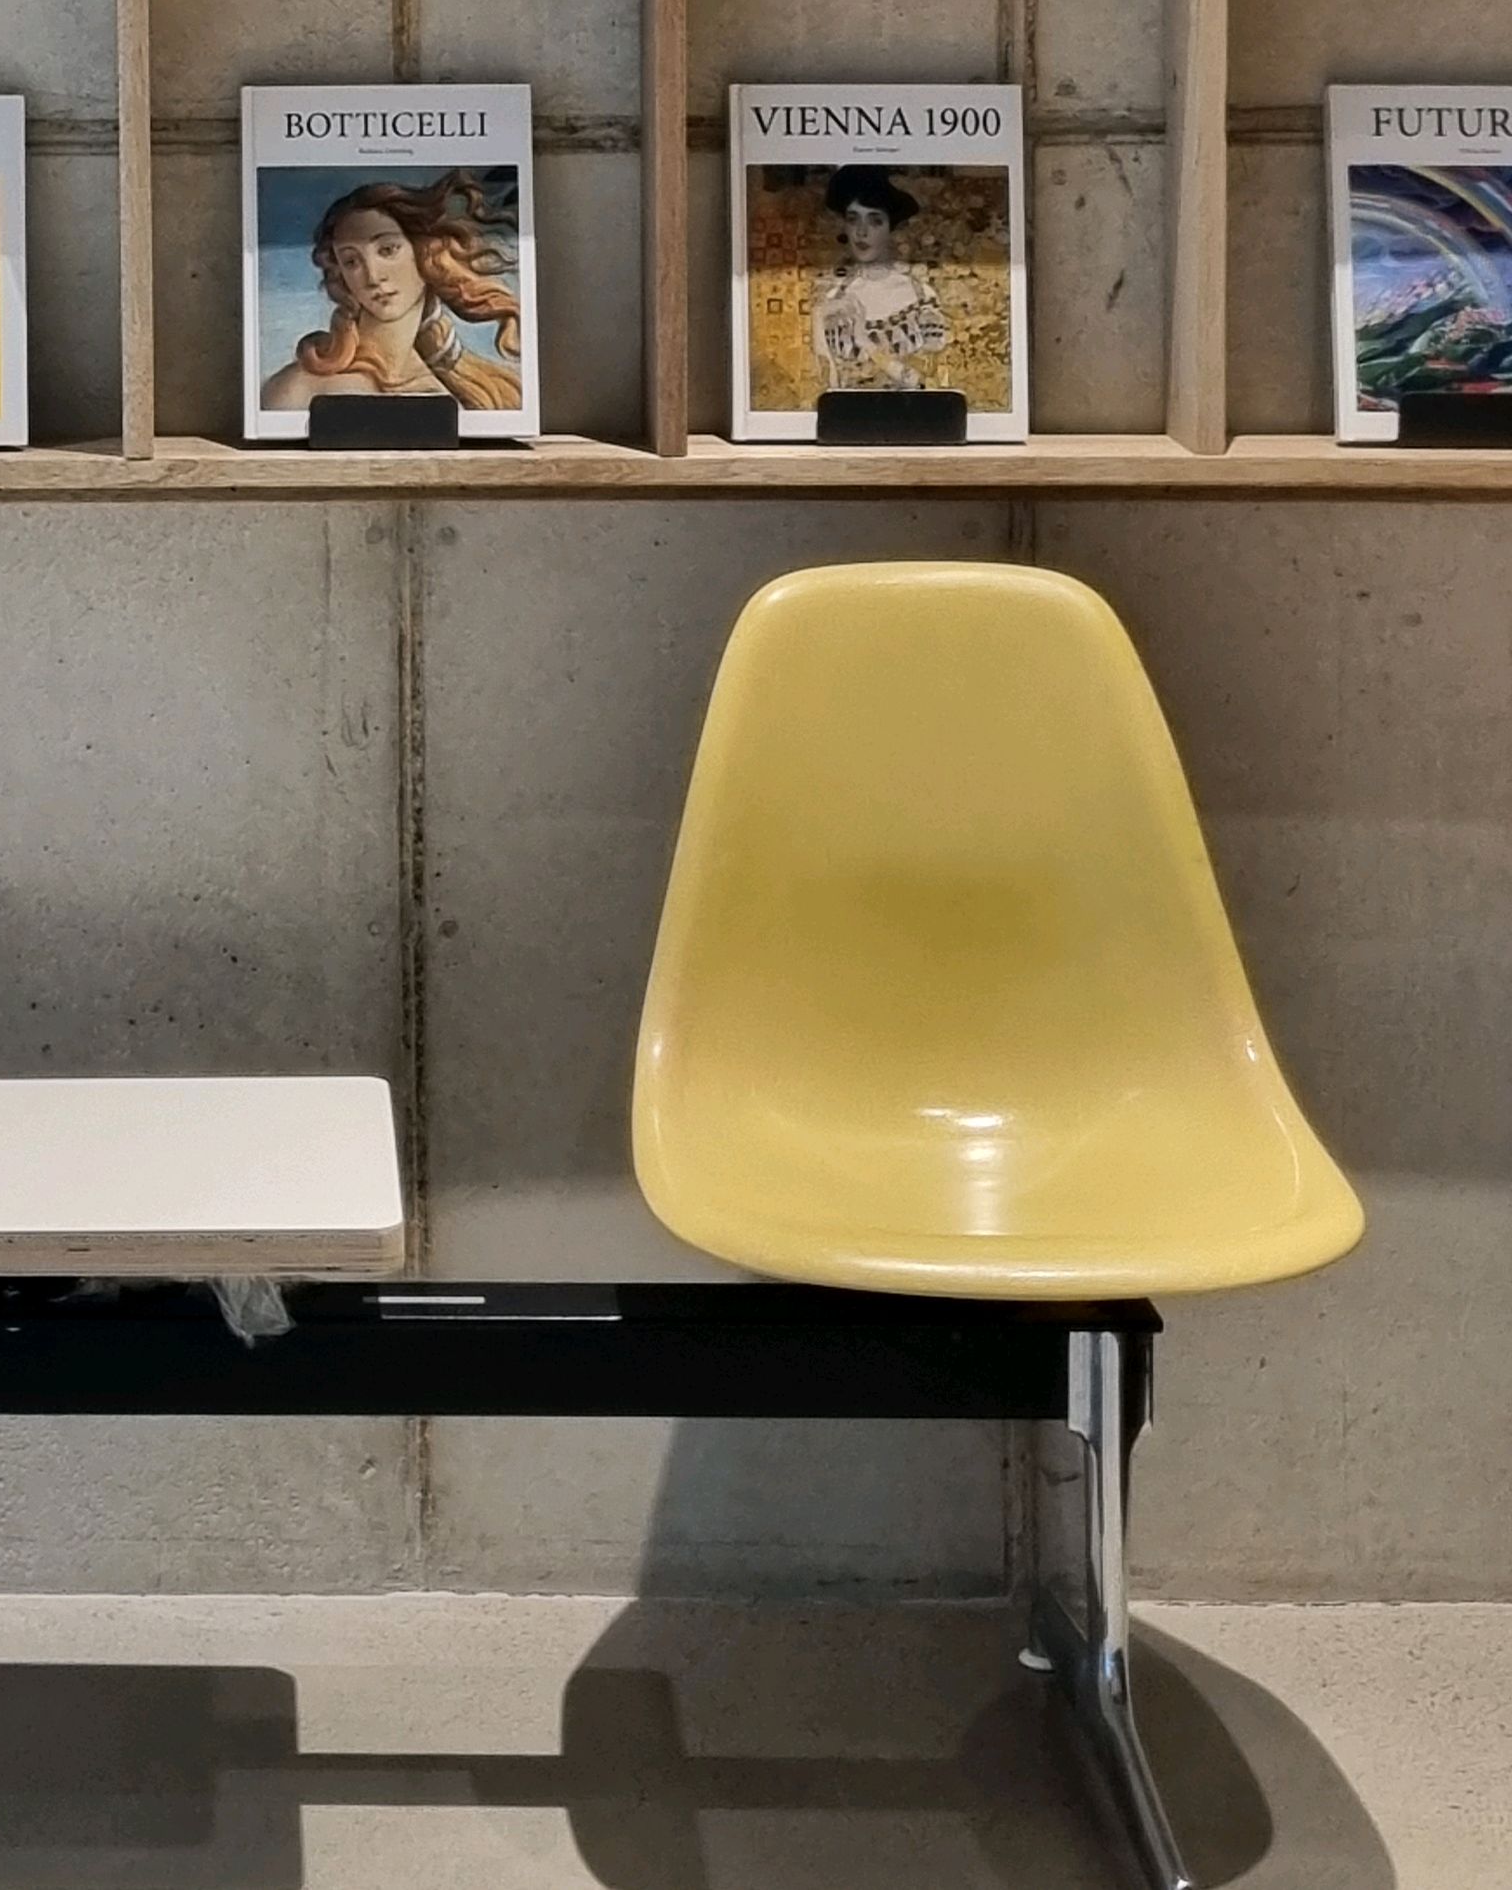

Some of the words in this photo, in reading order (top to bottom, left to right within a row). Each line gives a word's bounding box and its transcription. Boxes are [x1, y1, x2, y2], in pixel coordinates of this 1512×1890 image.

[283, 111, 488, 139] BOTTICELLI
[749, 106, 914, 137] VIENNA
[924, 106, 1002, 137] 1900
[1370, 106, 1512, 138] FUTUR
